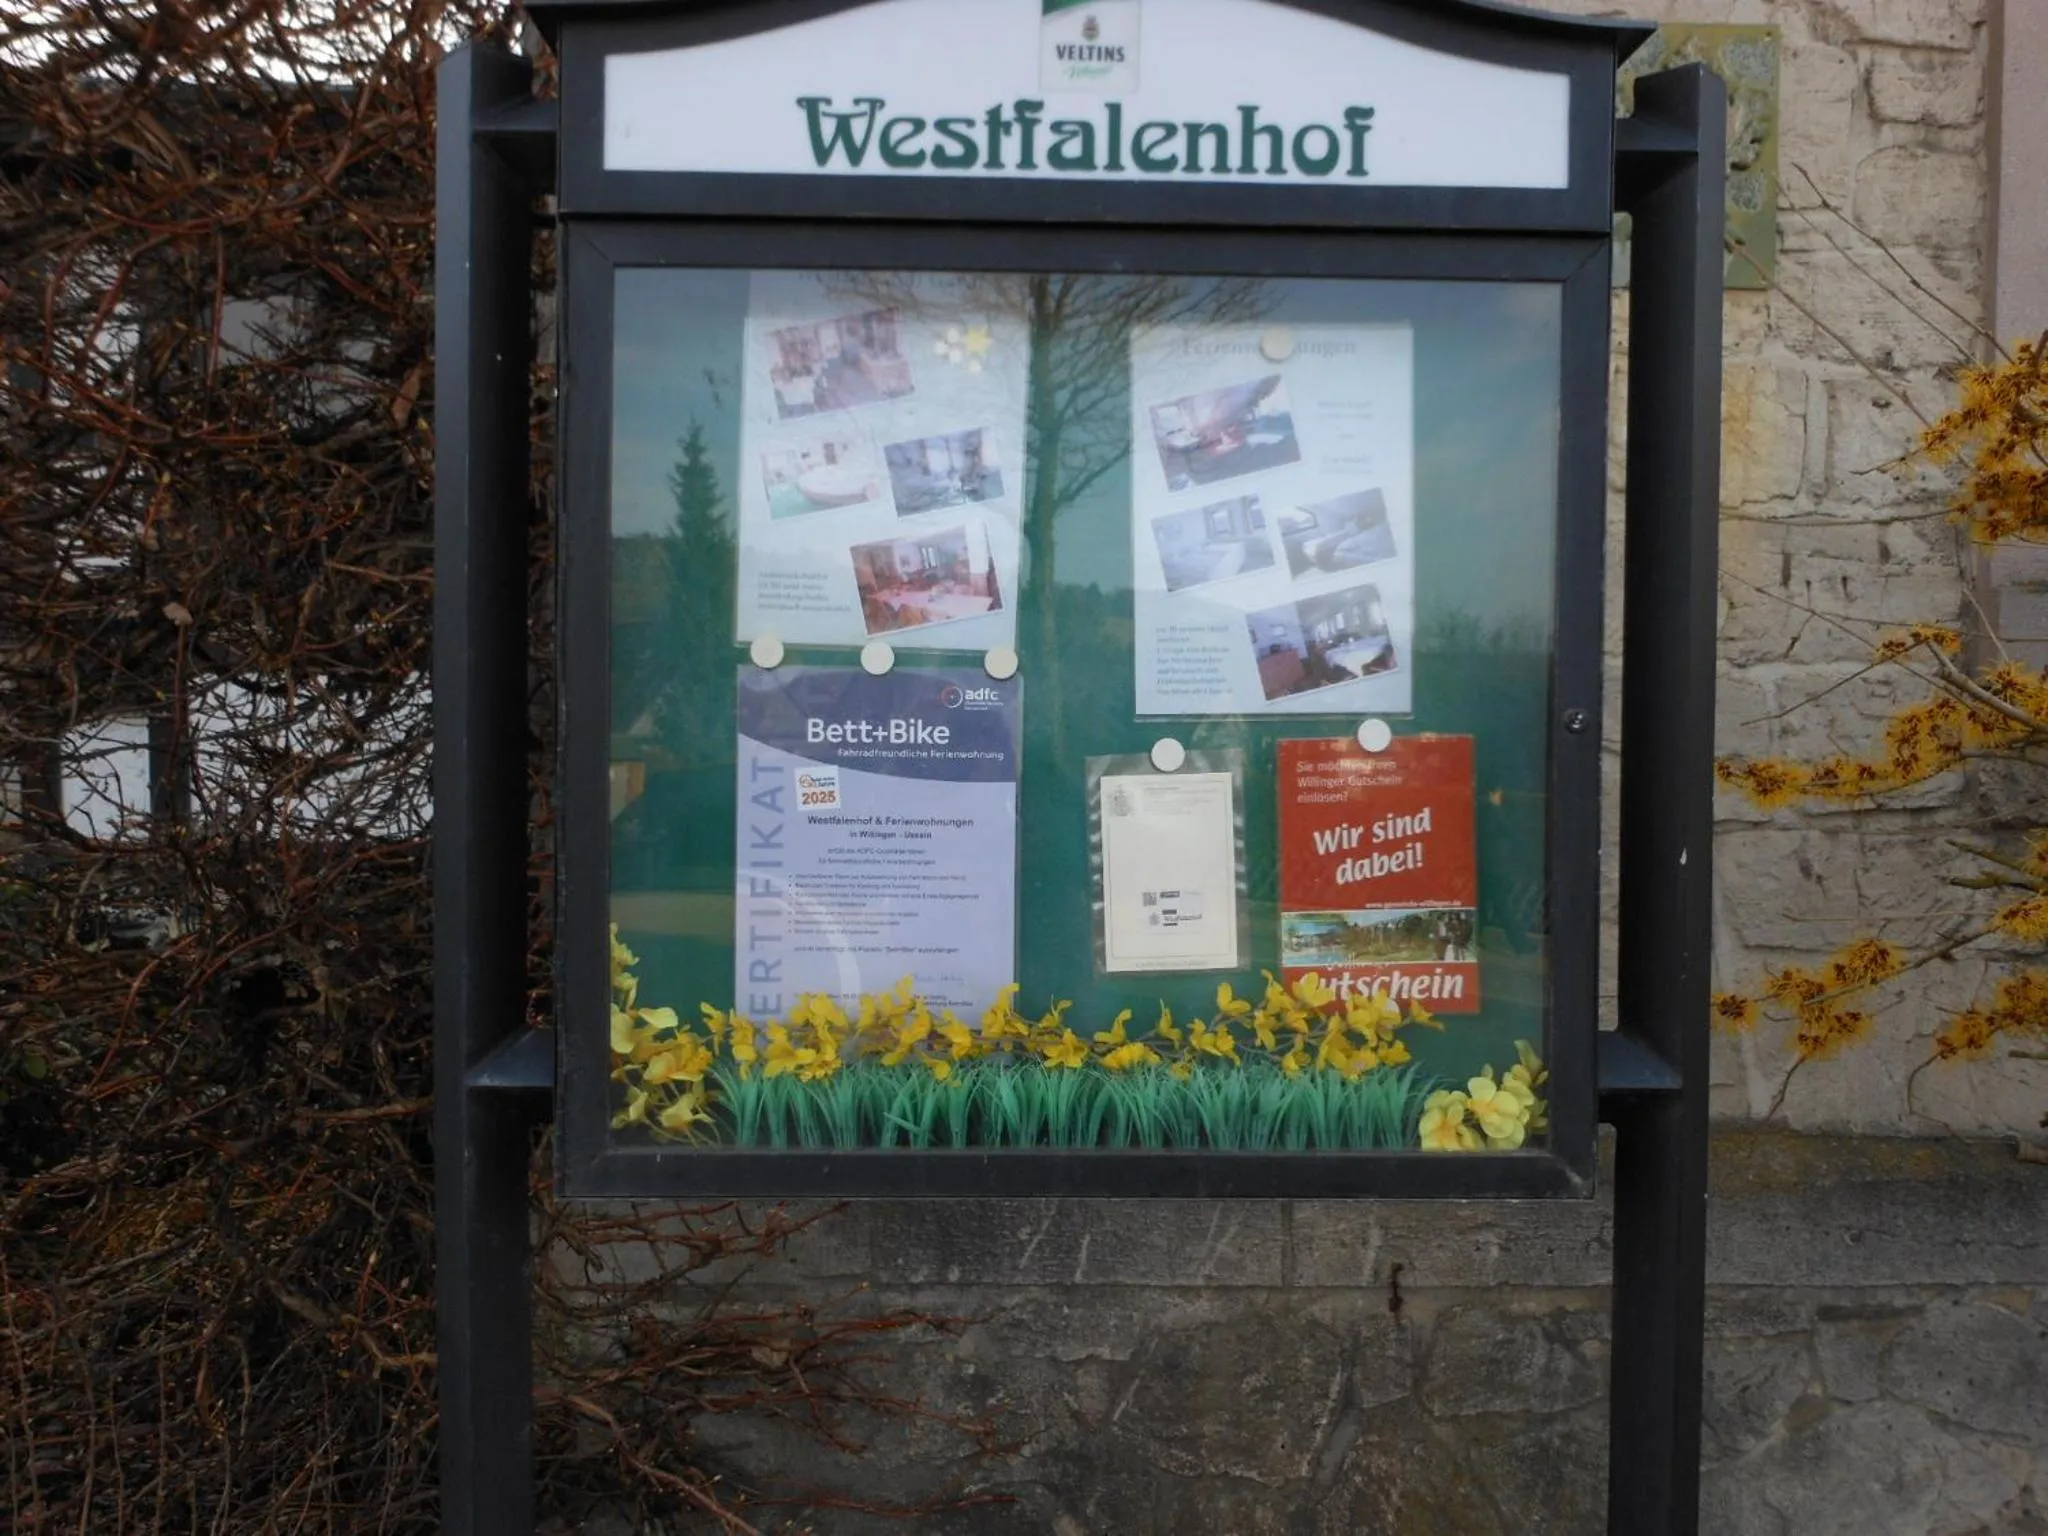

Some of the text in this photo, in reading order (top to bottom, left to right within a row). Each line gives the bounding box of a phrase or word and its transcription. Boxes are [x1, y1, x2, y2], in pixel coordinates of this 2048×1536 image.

[1056, 44, 1125, 63] VELTINS
[797, 96, 1375, 177] Westfalenhof
[964, 688, 1000, 701] adfc
[807, 718, 950, 745] Bett+Bike
[837, 748, 1005, 761] Fahrradfreundliche Ferienwohnung
[1296, 760, 1313, 772] Sie
[1297, 775, 1403, 788] Willinger Gutschein
[802, 791, 837, 806] 2025
[1297, 791, 1349, 804] einlösen?
[807, 815, 974, 829] Westfalenhof & Ferienwohnungen
[1313, 806, 1432, 856] Wir sind
[1336, 842, 1424, 885] dabei!
[749, 757, 785, 1040] ERTIFIKAT
[1300, 968, 1464, 1001] utschein
